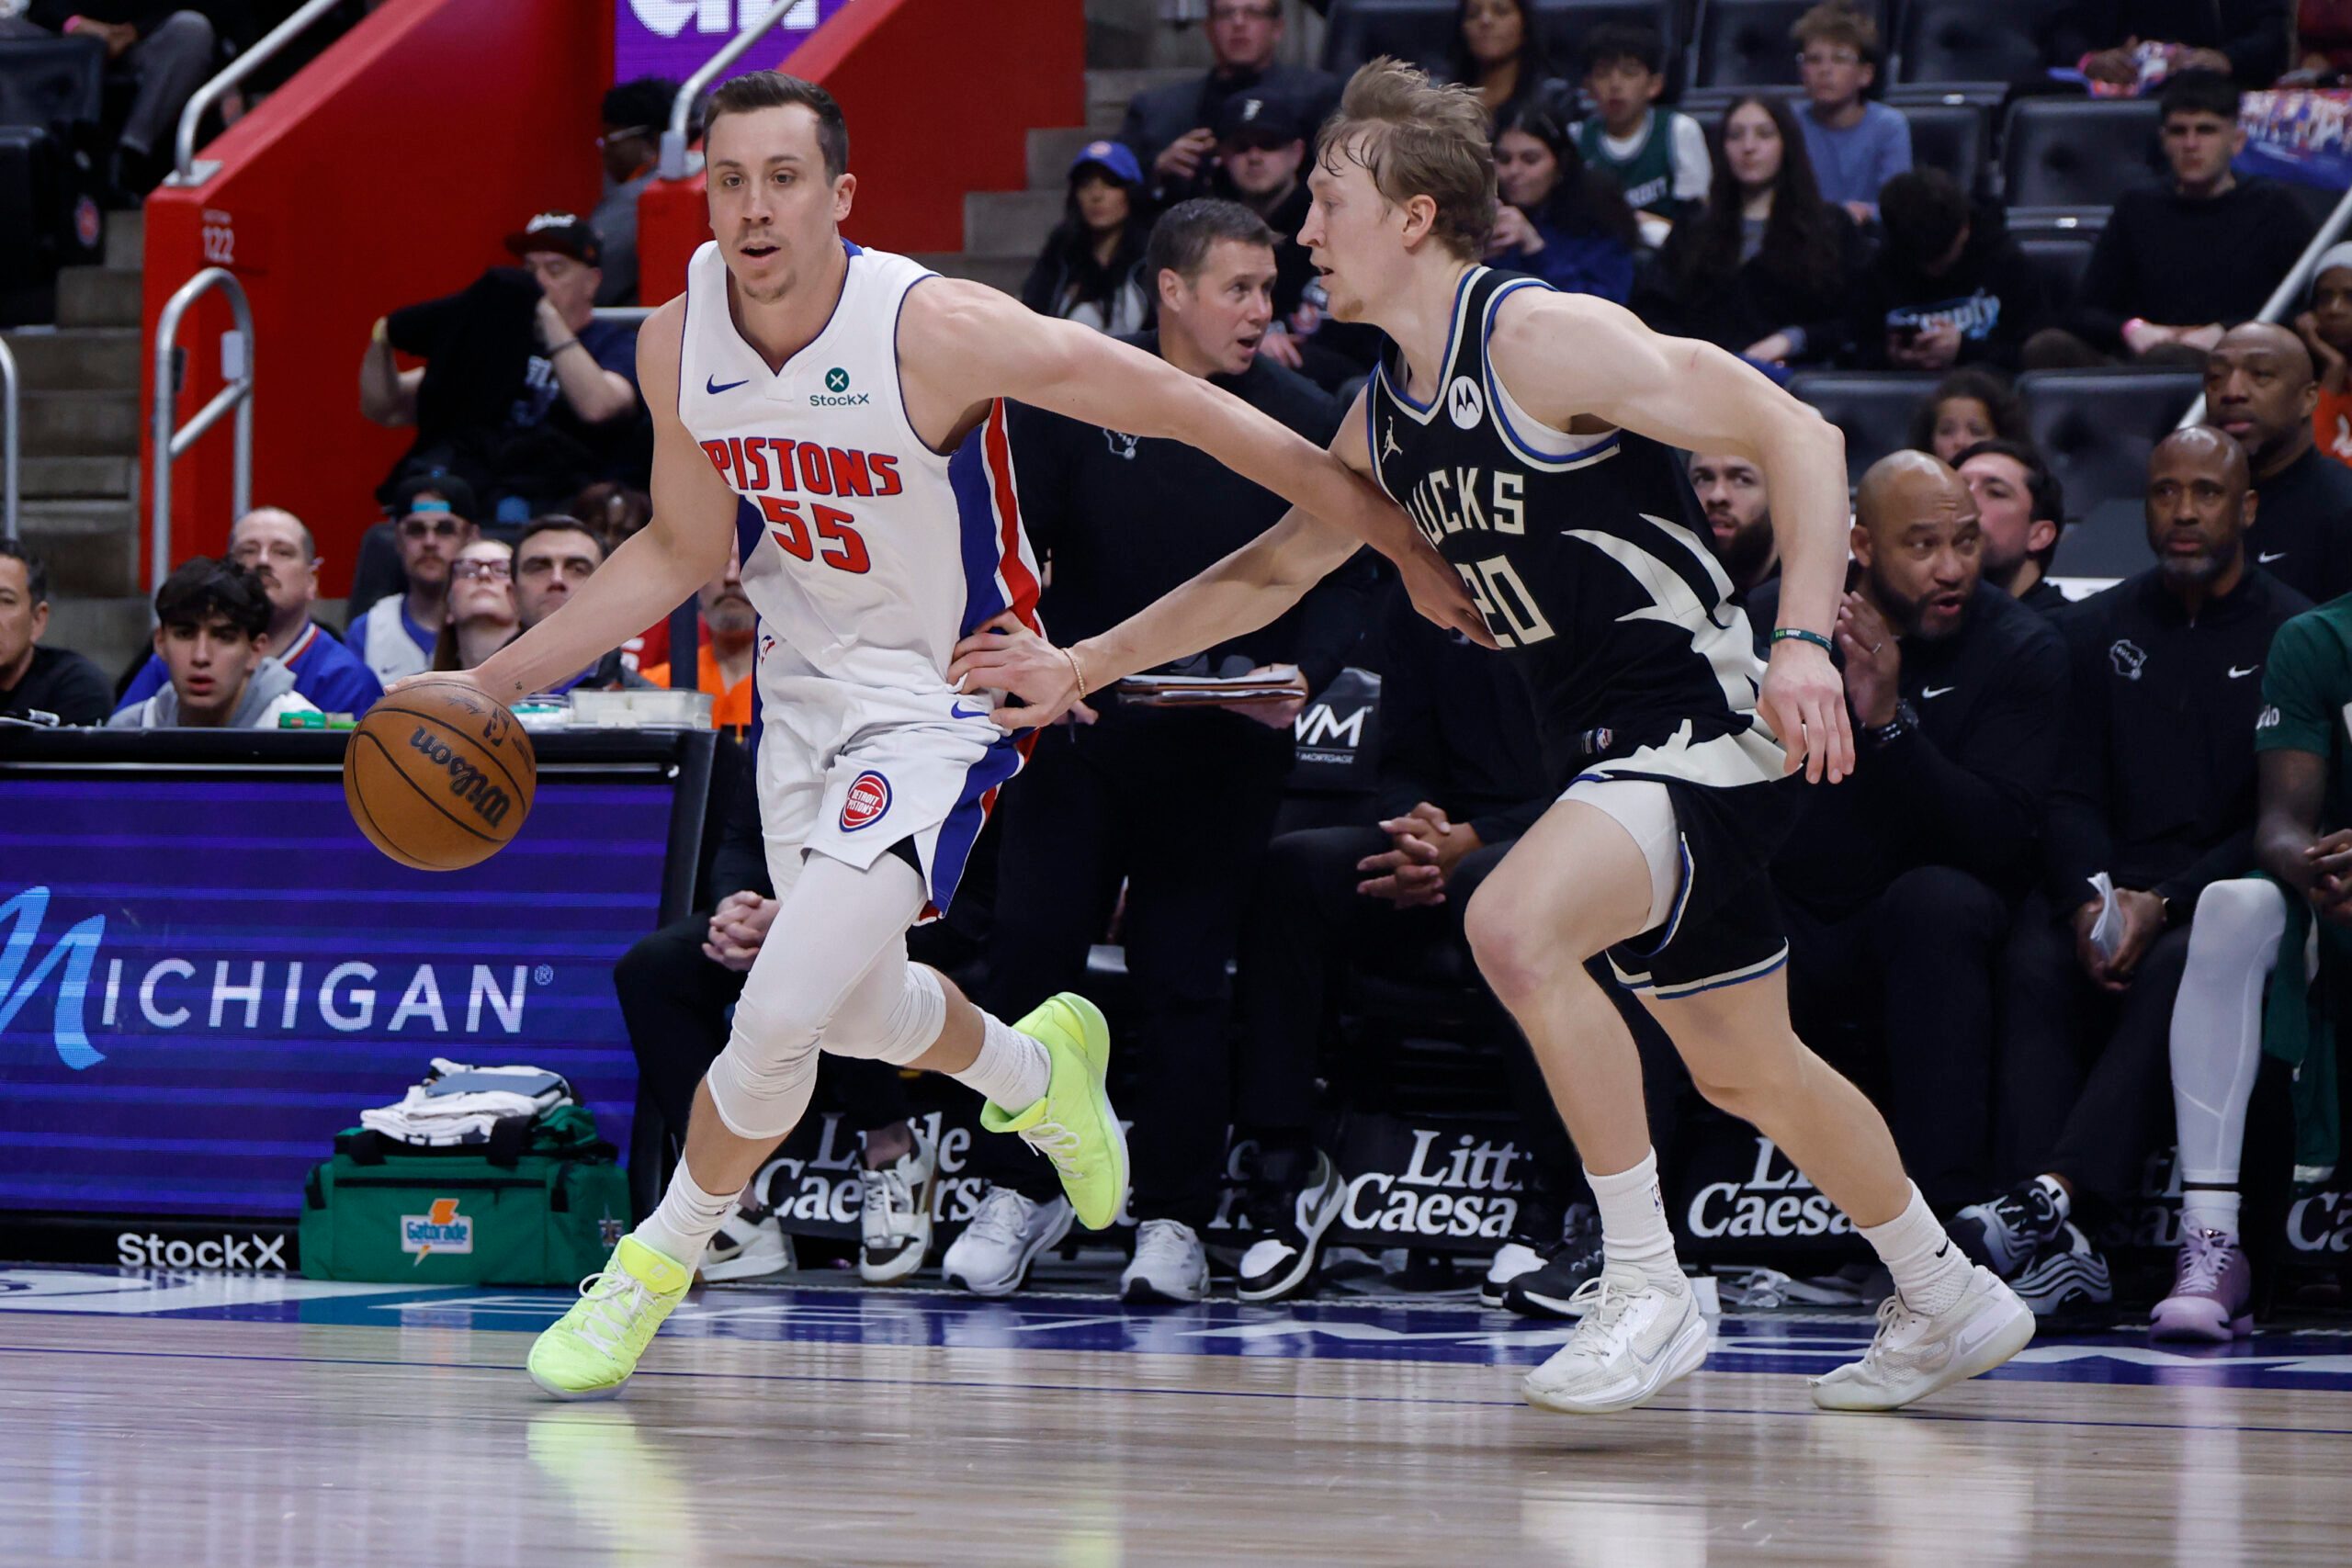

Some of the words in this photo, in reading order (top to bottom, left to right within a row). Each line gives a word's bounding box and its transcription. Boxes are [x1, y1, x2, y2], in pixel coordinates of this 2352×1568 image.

[202, 226, 235, 265] 122
[809, 392, 870, 407] StockX
[699, 436, 903, 498] PISTONS
[757, 495, 871, 574] 55
[1453, 554, 1556, 649] 20
[410, 725, 512, 829] Wilson
[846, 798, 875, 816] PISTONS
[851, 788, 881, 807] DETROIT
[755, 1158, 982, 1224] Caers
[117, 1232, 287, 1270] StockX
[406, 1221, 468, 1242] Gatorade
